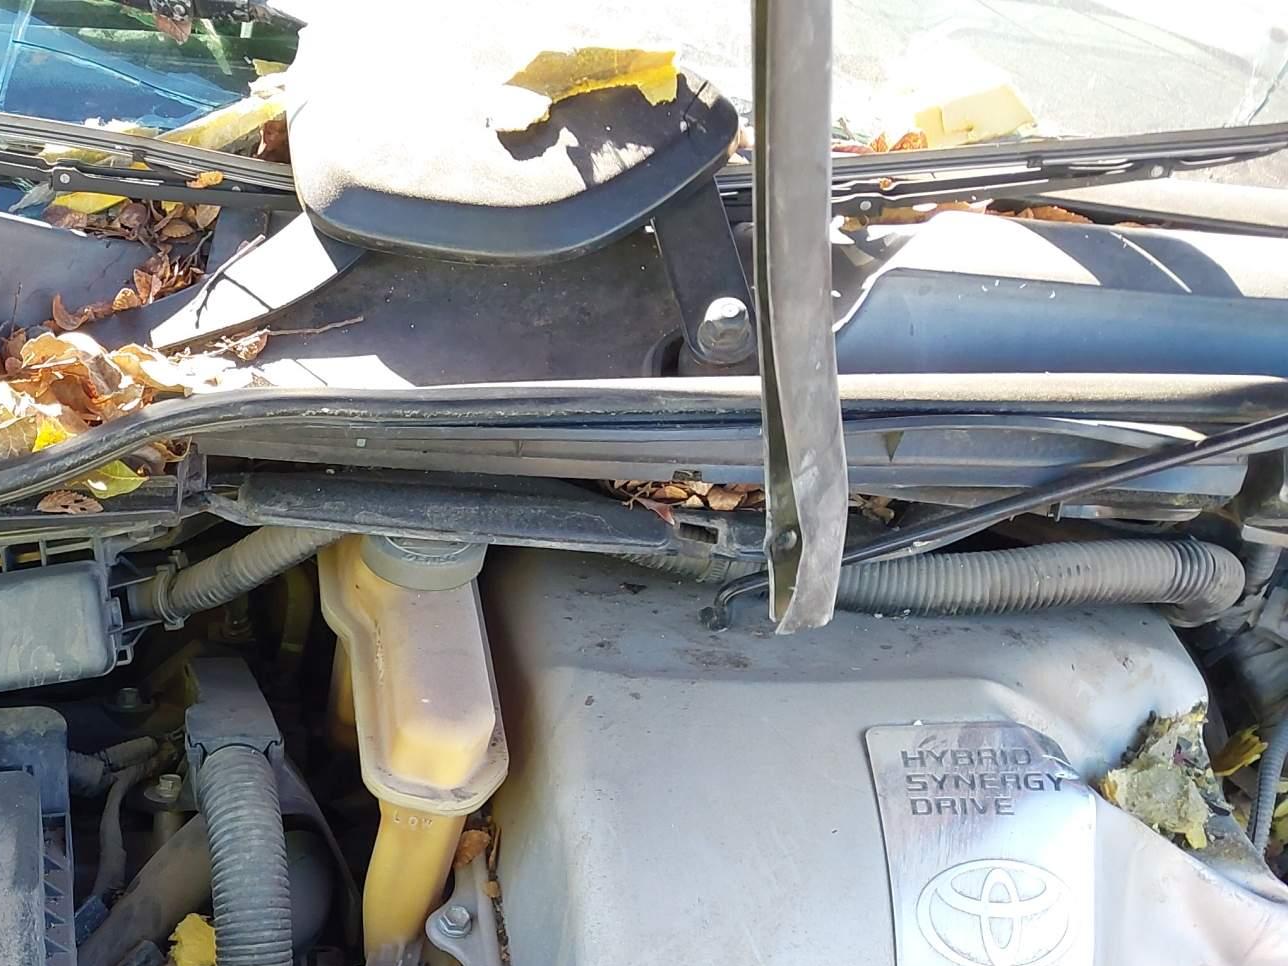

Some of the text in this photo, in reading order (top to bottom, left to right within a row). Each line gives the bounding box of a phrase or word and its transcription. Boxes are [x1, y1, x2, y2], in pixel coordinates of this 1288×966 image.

[900, 749, 1033, 768] HYBRID
[905, 772, 1065, 792] SYNERGY
[910, 797, 1015, 816] DRIVE
